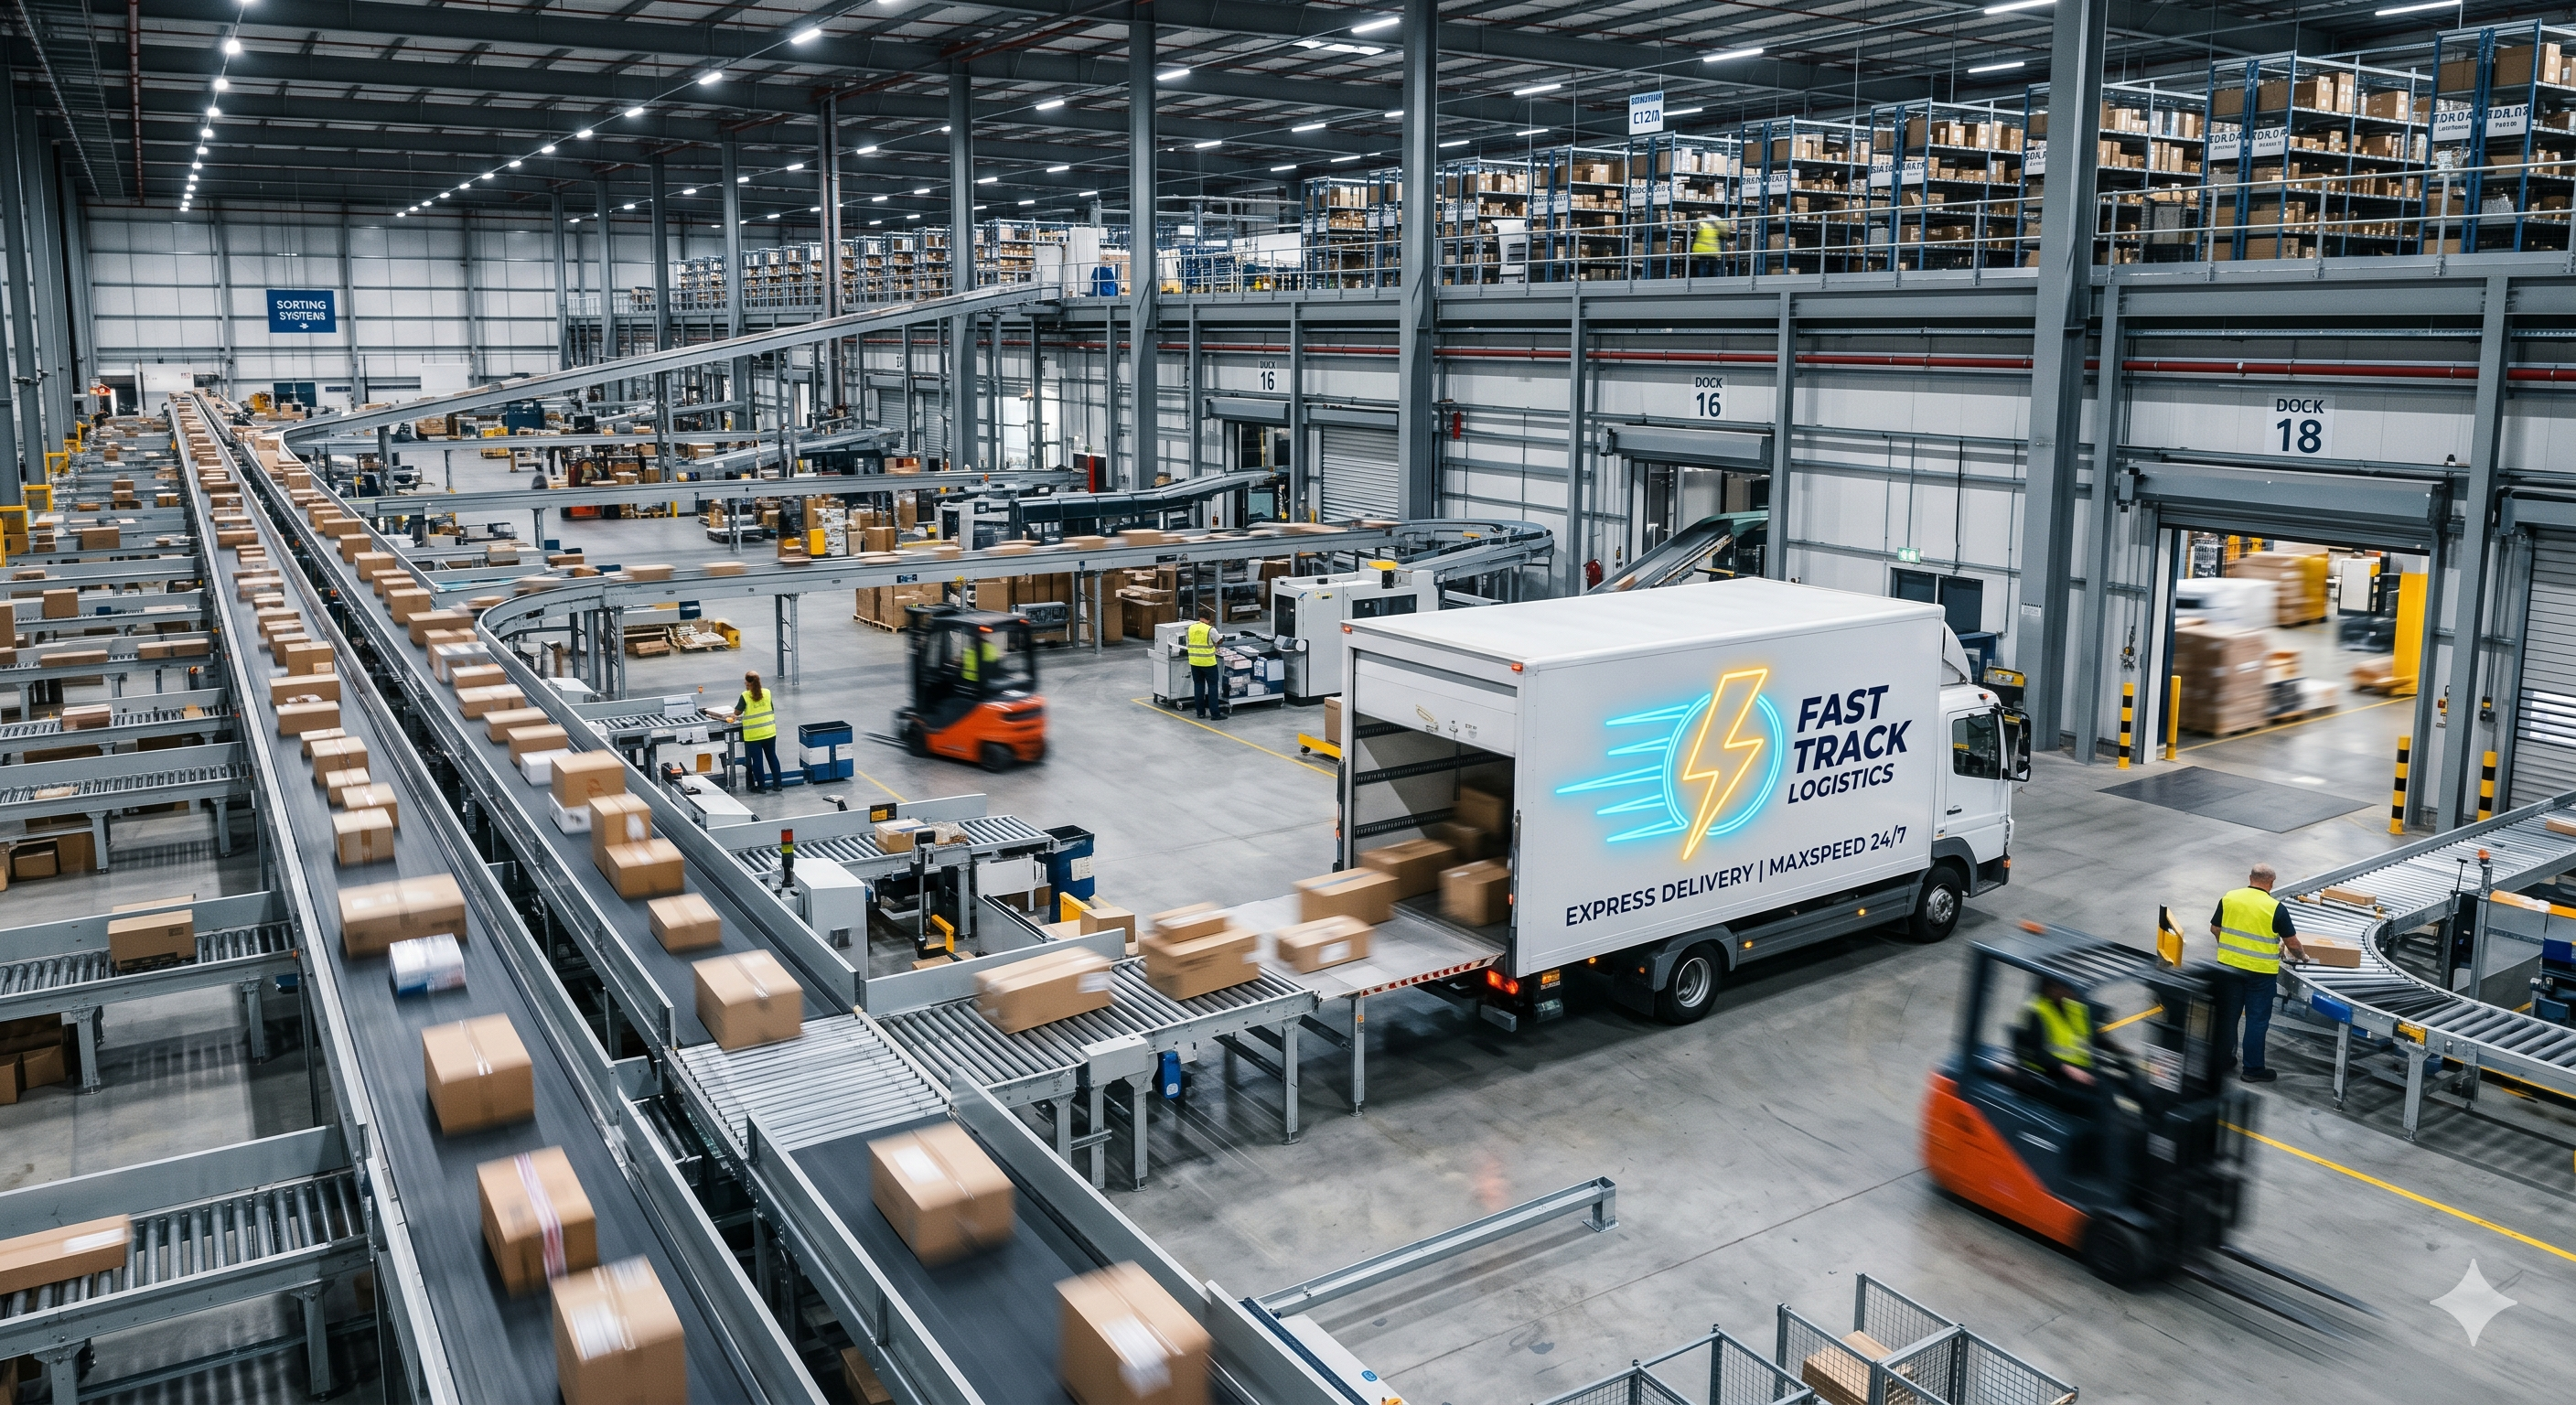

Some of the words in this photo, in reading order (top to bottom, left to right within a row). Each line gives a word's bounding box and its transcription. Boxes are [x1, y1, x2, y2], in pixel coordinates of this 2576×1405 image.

[276, 300, 327, 310] SORTING
[1261, 370, 1274, 391] 16
[1695, 376, 1723, 388] DOCK
[1696, 391, 1722, 417] 16
[2276, 398, 2324, 414] DOCK
[2276, 418, 2323, 454] 18
[1797, 684, 1890, 734] FAST
[1793, 719, 1913, 774] TRACK
[1787, 763, 1894, 804] LOGISTICS
[1565, 887, 1657, 927] EXPRESS
[1661, 863, 1755, 903] DELIVERY
[1769, 836, 1866, 876] MAXSPEED
[1870, 824, 1907, 852] 24/7
